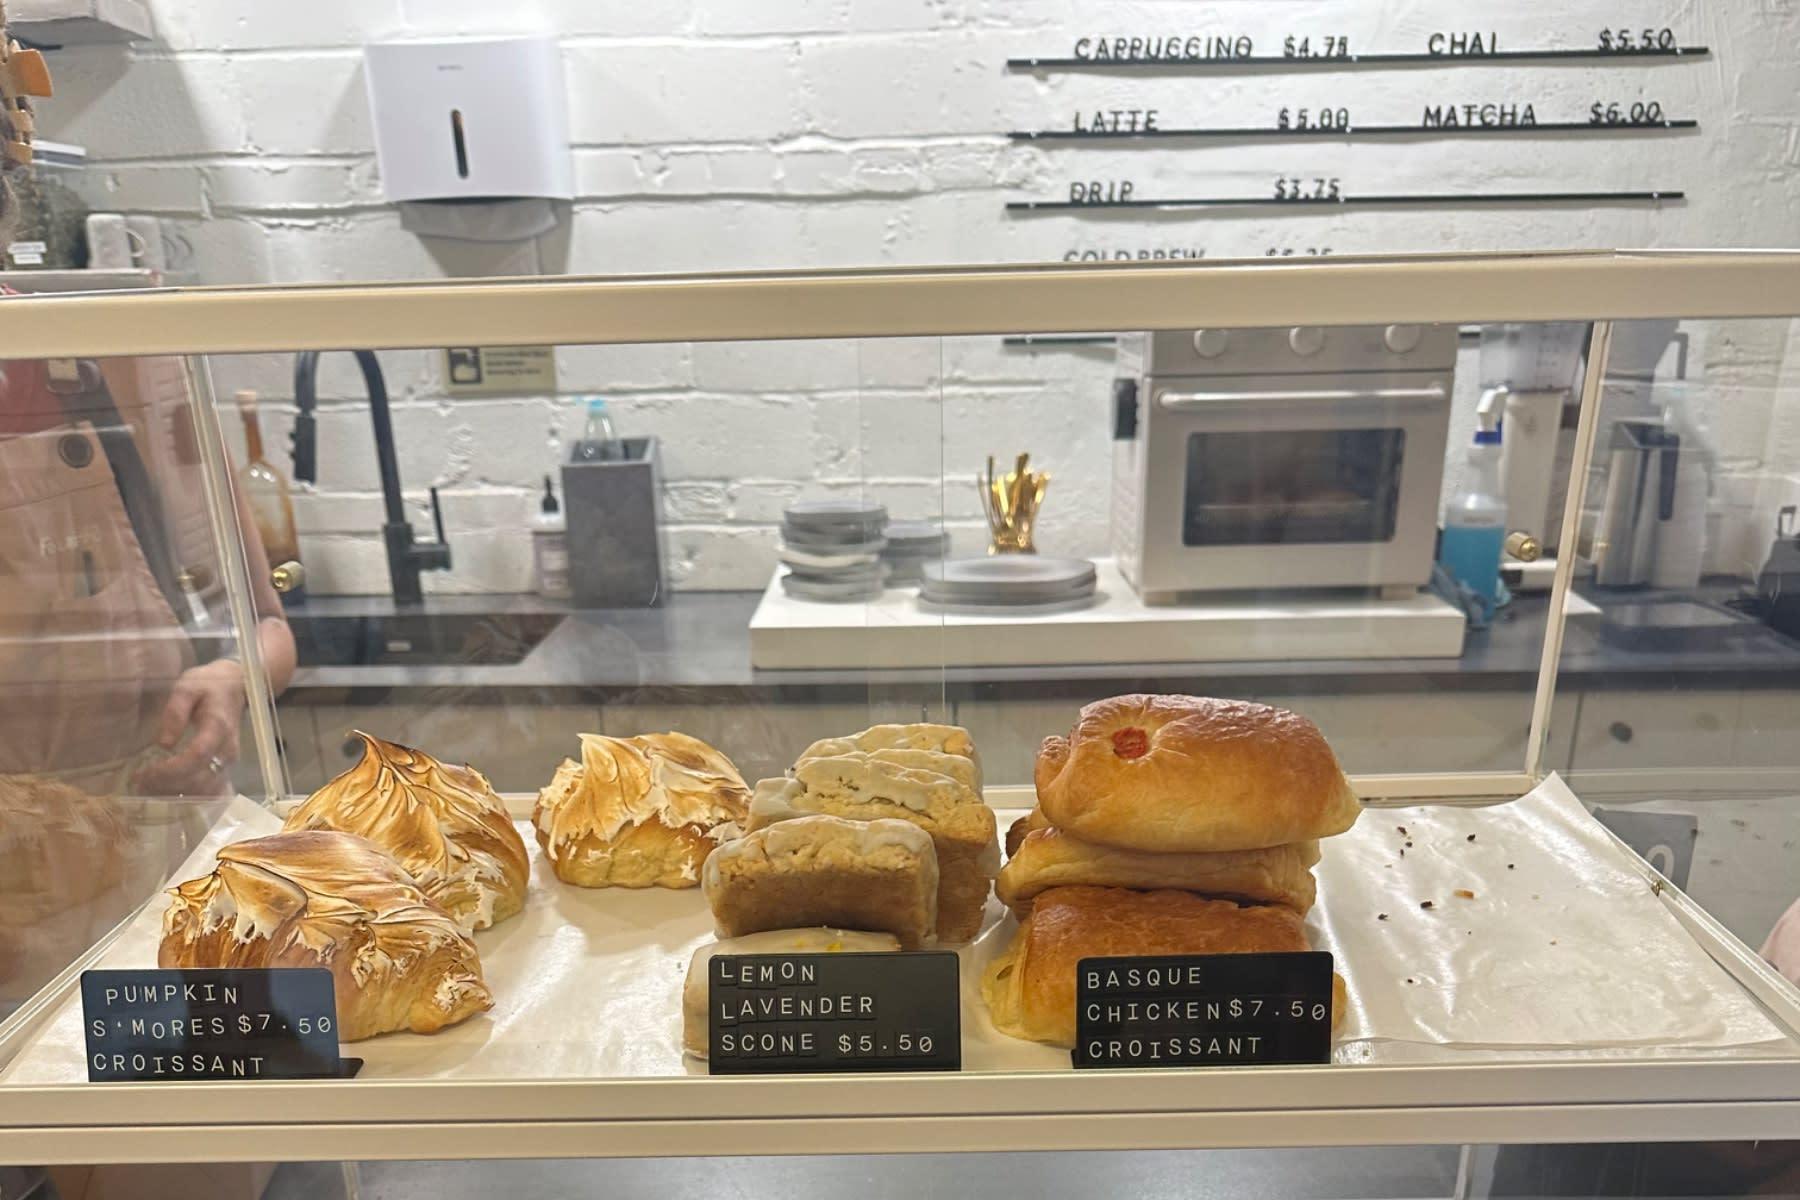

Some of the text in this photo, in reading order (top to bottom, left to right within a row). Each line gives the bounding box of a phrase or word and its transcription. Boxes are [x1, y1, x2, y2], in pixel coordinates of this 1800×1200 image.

[1074, 36, 1348, 60] CAPPUCCINO $4.75
[1428, 28, 1674, 54] CHAI $5.50
[1074, 108, 1349, 132] LATTE $5.00
[1423, 101, 1661, 126] MATCHA $6.00
[1070, 178, 1340, 202] DRIP $3.75
[721, 962, 814, 983] LEMON
[1087, 967, 1201, 989] BASQUE
[106, 983, 237, 1005] PUMPKIN
[722, 996, 873, 1019] LAVENDER
[1087, 999, 1326, 1023] CHICKEN $7.50
[93, 1014, 331, 1039] S'MORES $7.50
[722, 1033, 932, 1054] SCONE $5.50
[1089, 1037, 1261, 1059] CROISSANT
[94, 1054, 263, 1076] CROISSANT
